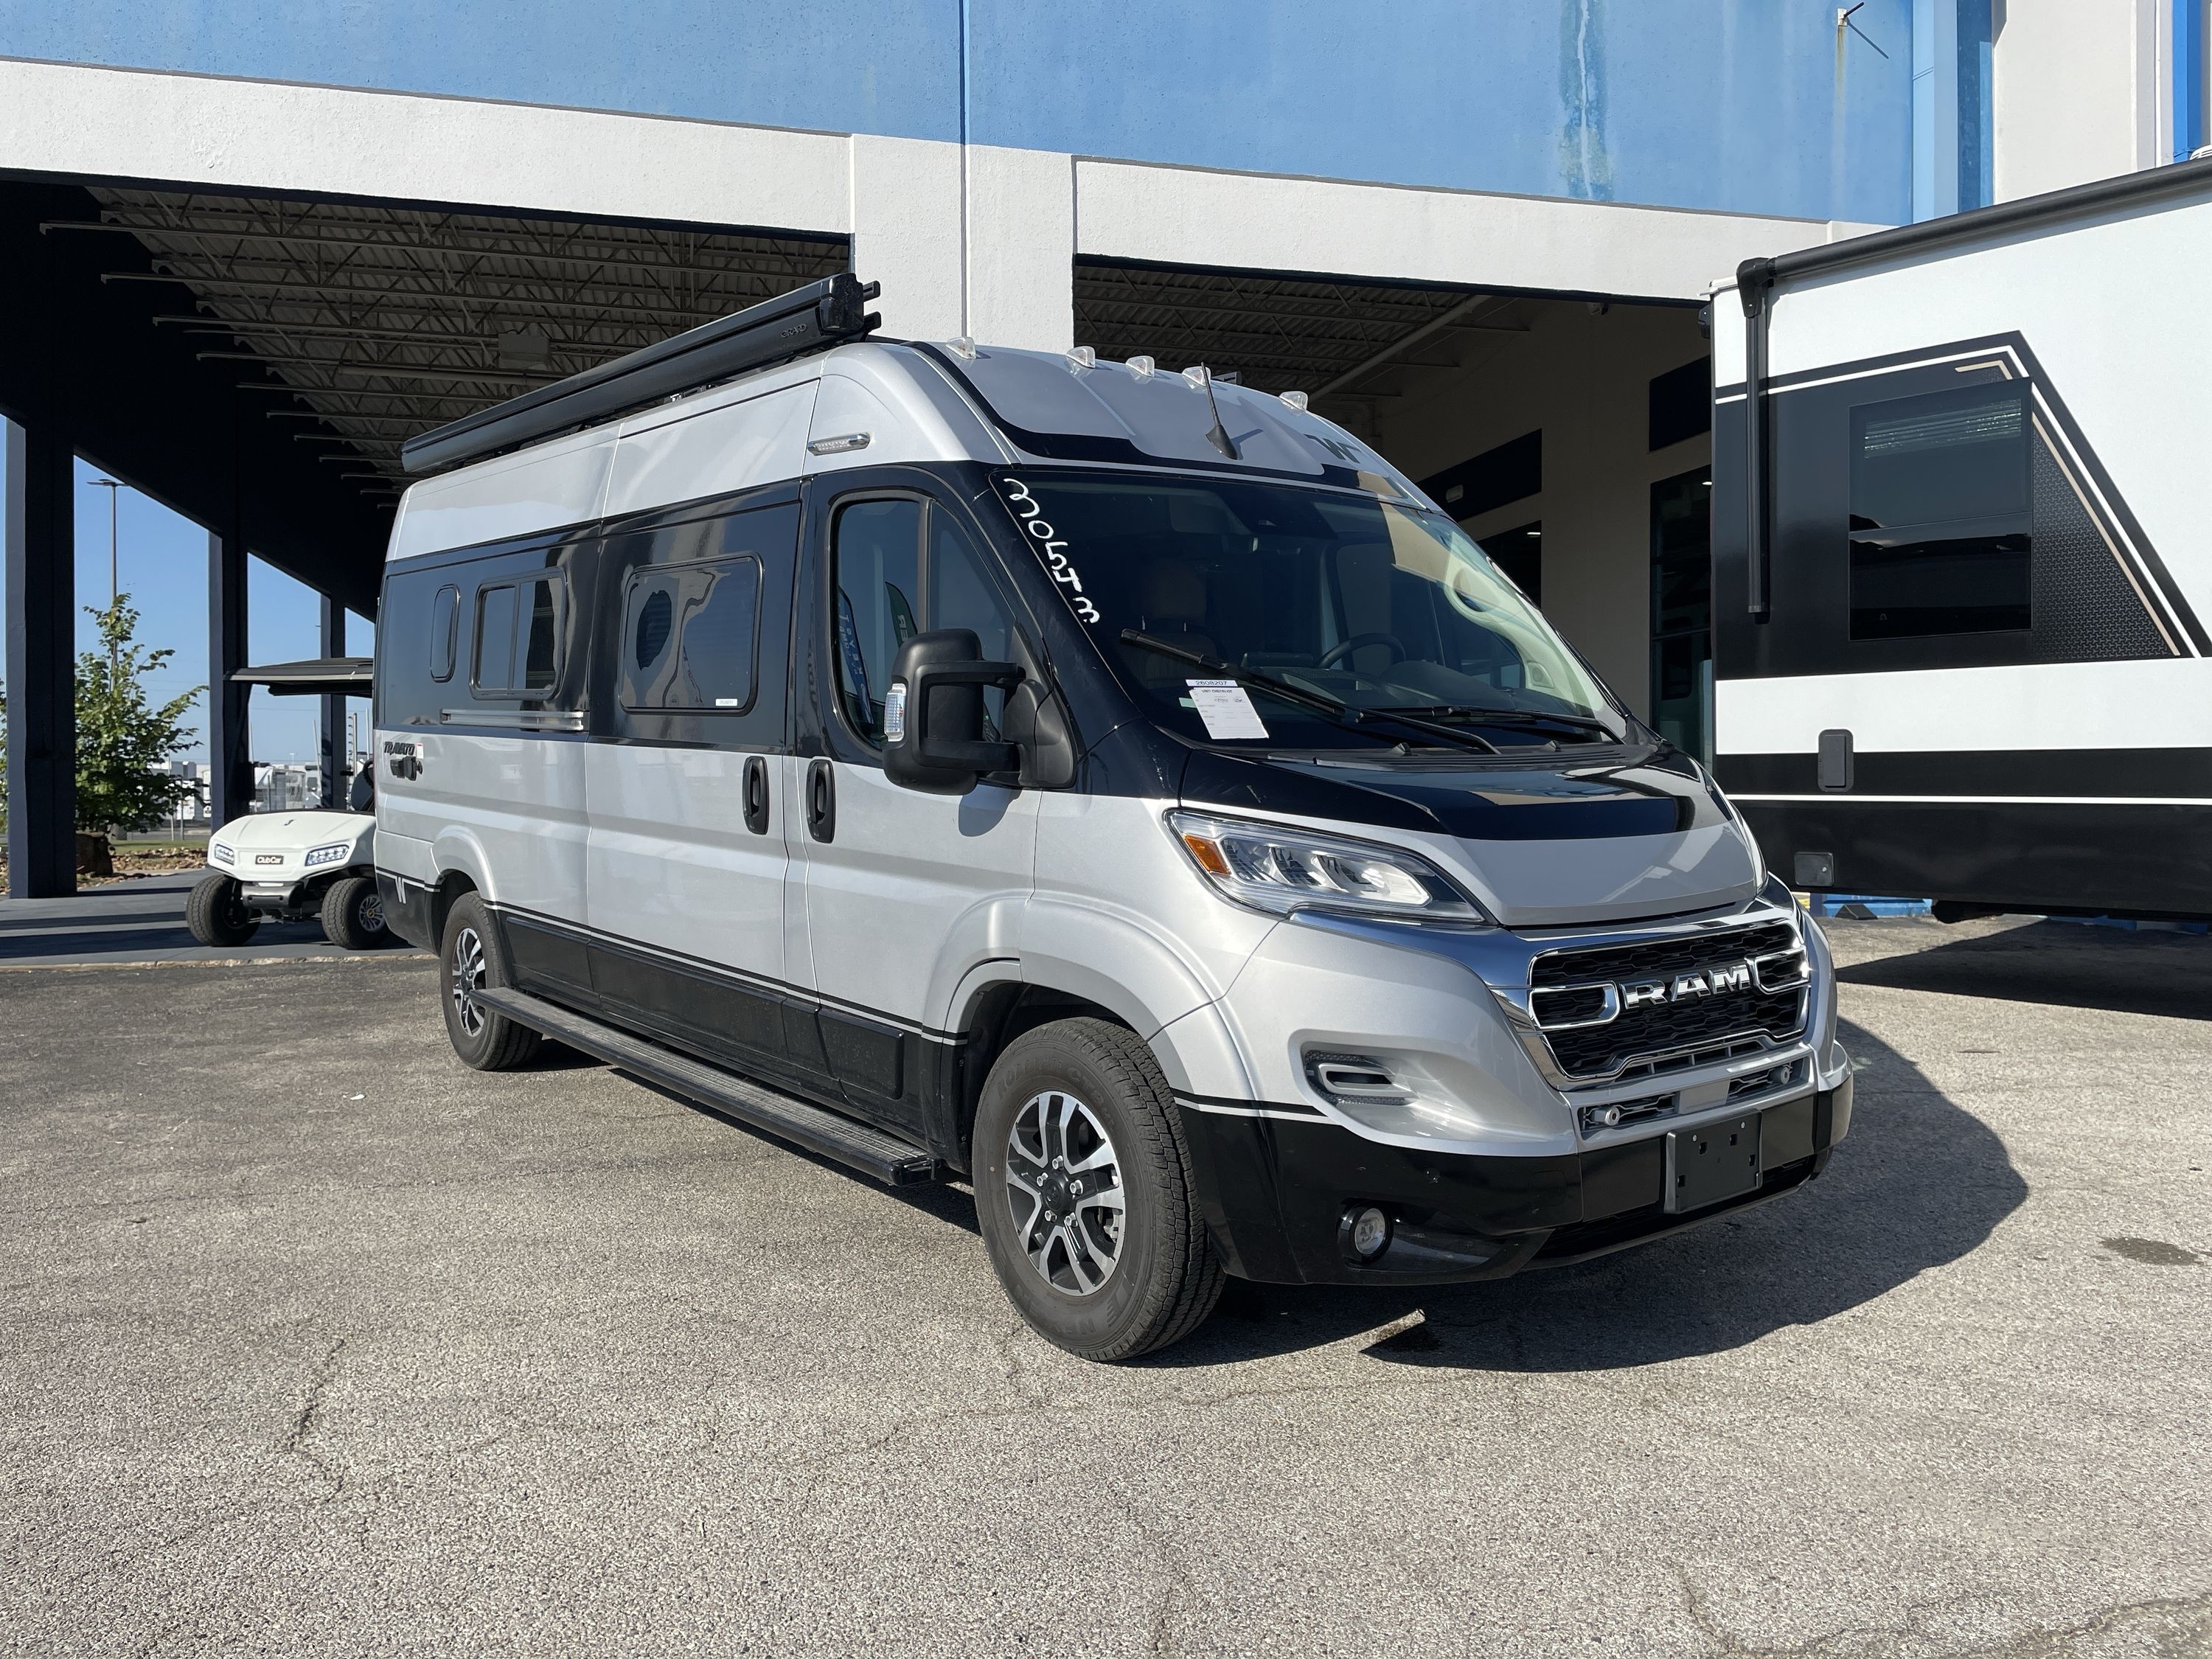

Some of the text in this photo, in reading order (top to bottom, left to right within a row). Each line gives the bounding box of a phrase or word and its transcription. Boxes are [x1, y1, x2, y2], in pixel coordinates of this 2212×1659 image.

[1003, 478, 1100, 624] 30543
[383, 741, 415, 756] TRAVATO
[1620, 965, 1750, 1009] RAM
